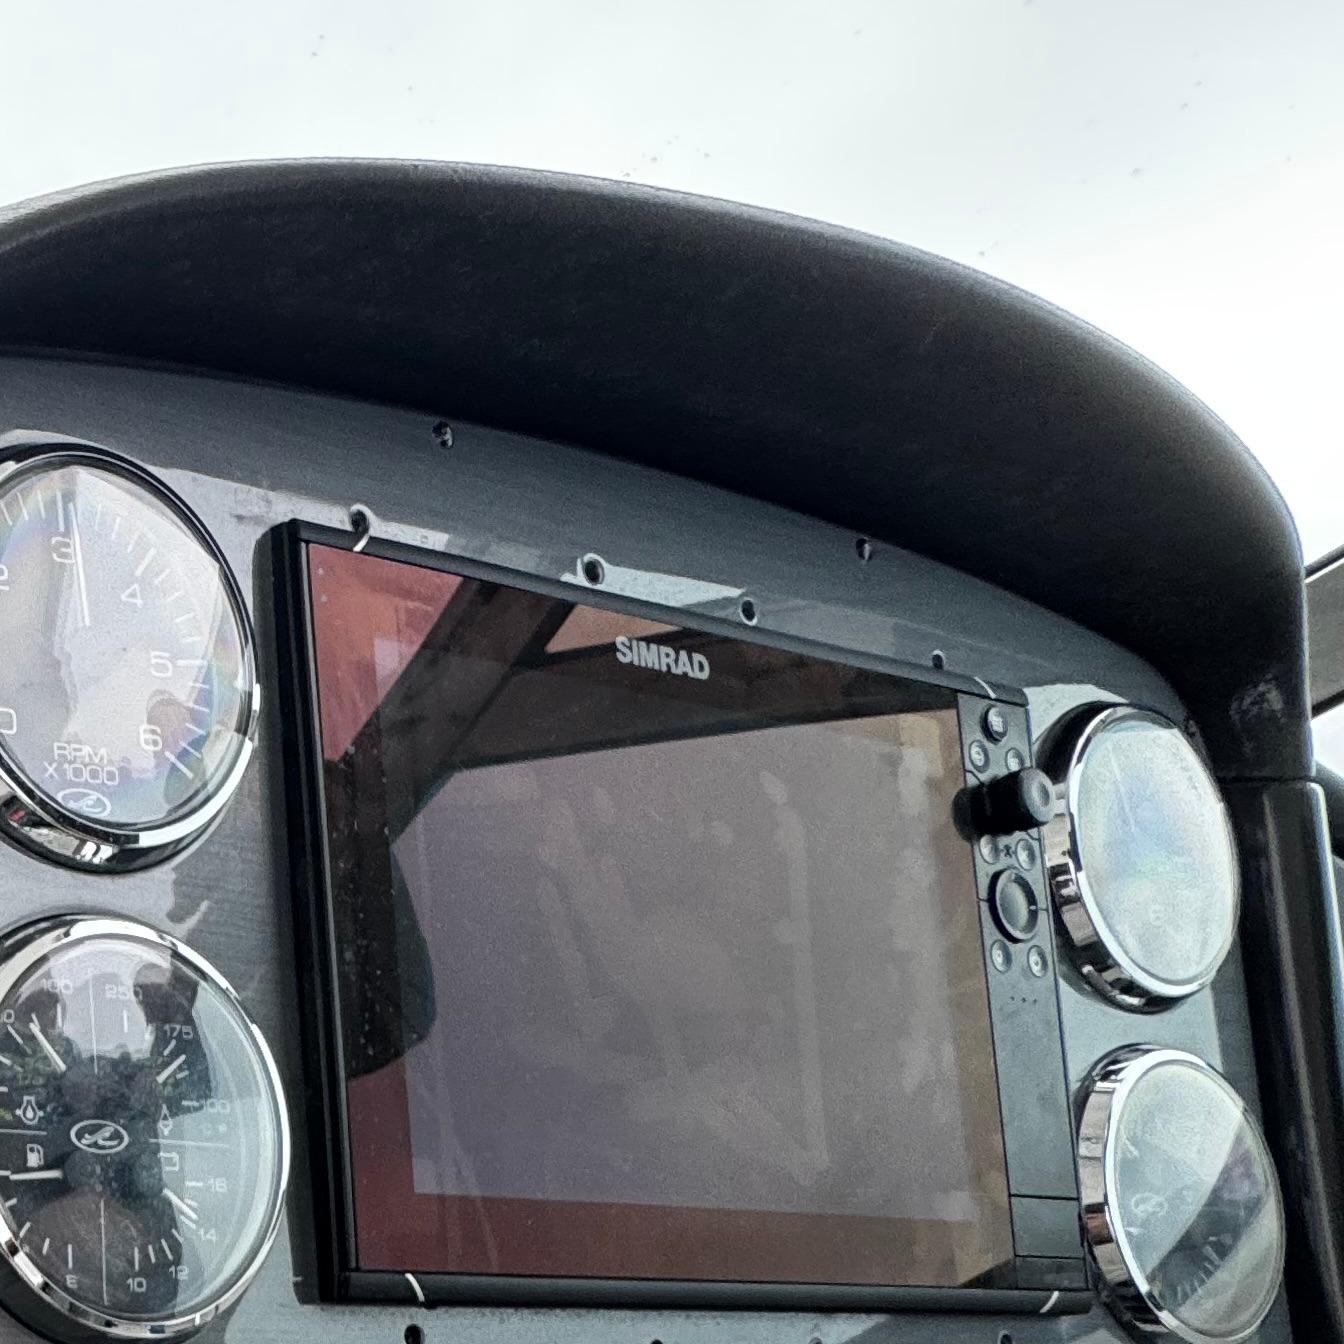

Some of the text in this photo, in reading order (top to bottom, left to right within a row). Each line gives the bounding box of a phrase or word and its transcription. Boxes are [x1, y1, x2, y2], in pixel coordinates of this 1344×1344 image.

[51, 536, 76, 564] 3
[120, 584, 143, 608] 4
[149, 652, 174, 678] 5
[615, 635, 711, 681] SIMRAD
[138, 724, 164, 752] 6
[52, 741, 109, 763] RPM
[43, 761, 120, 787] X 1000
[127, 1276, 147, 1293] 10
